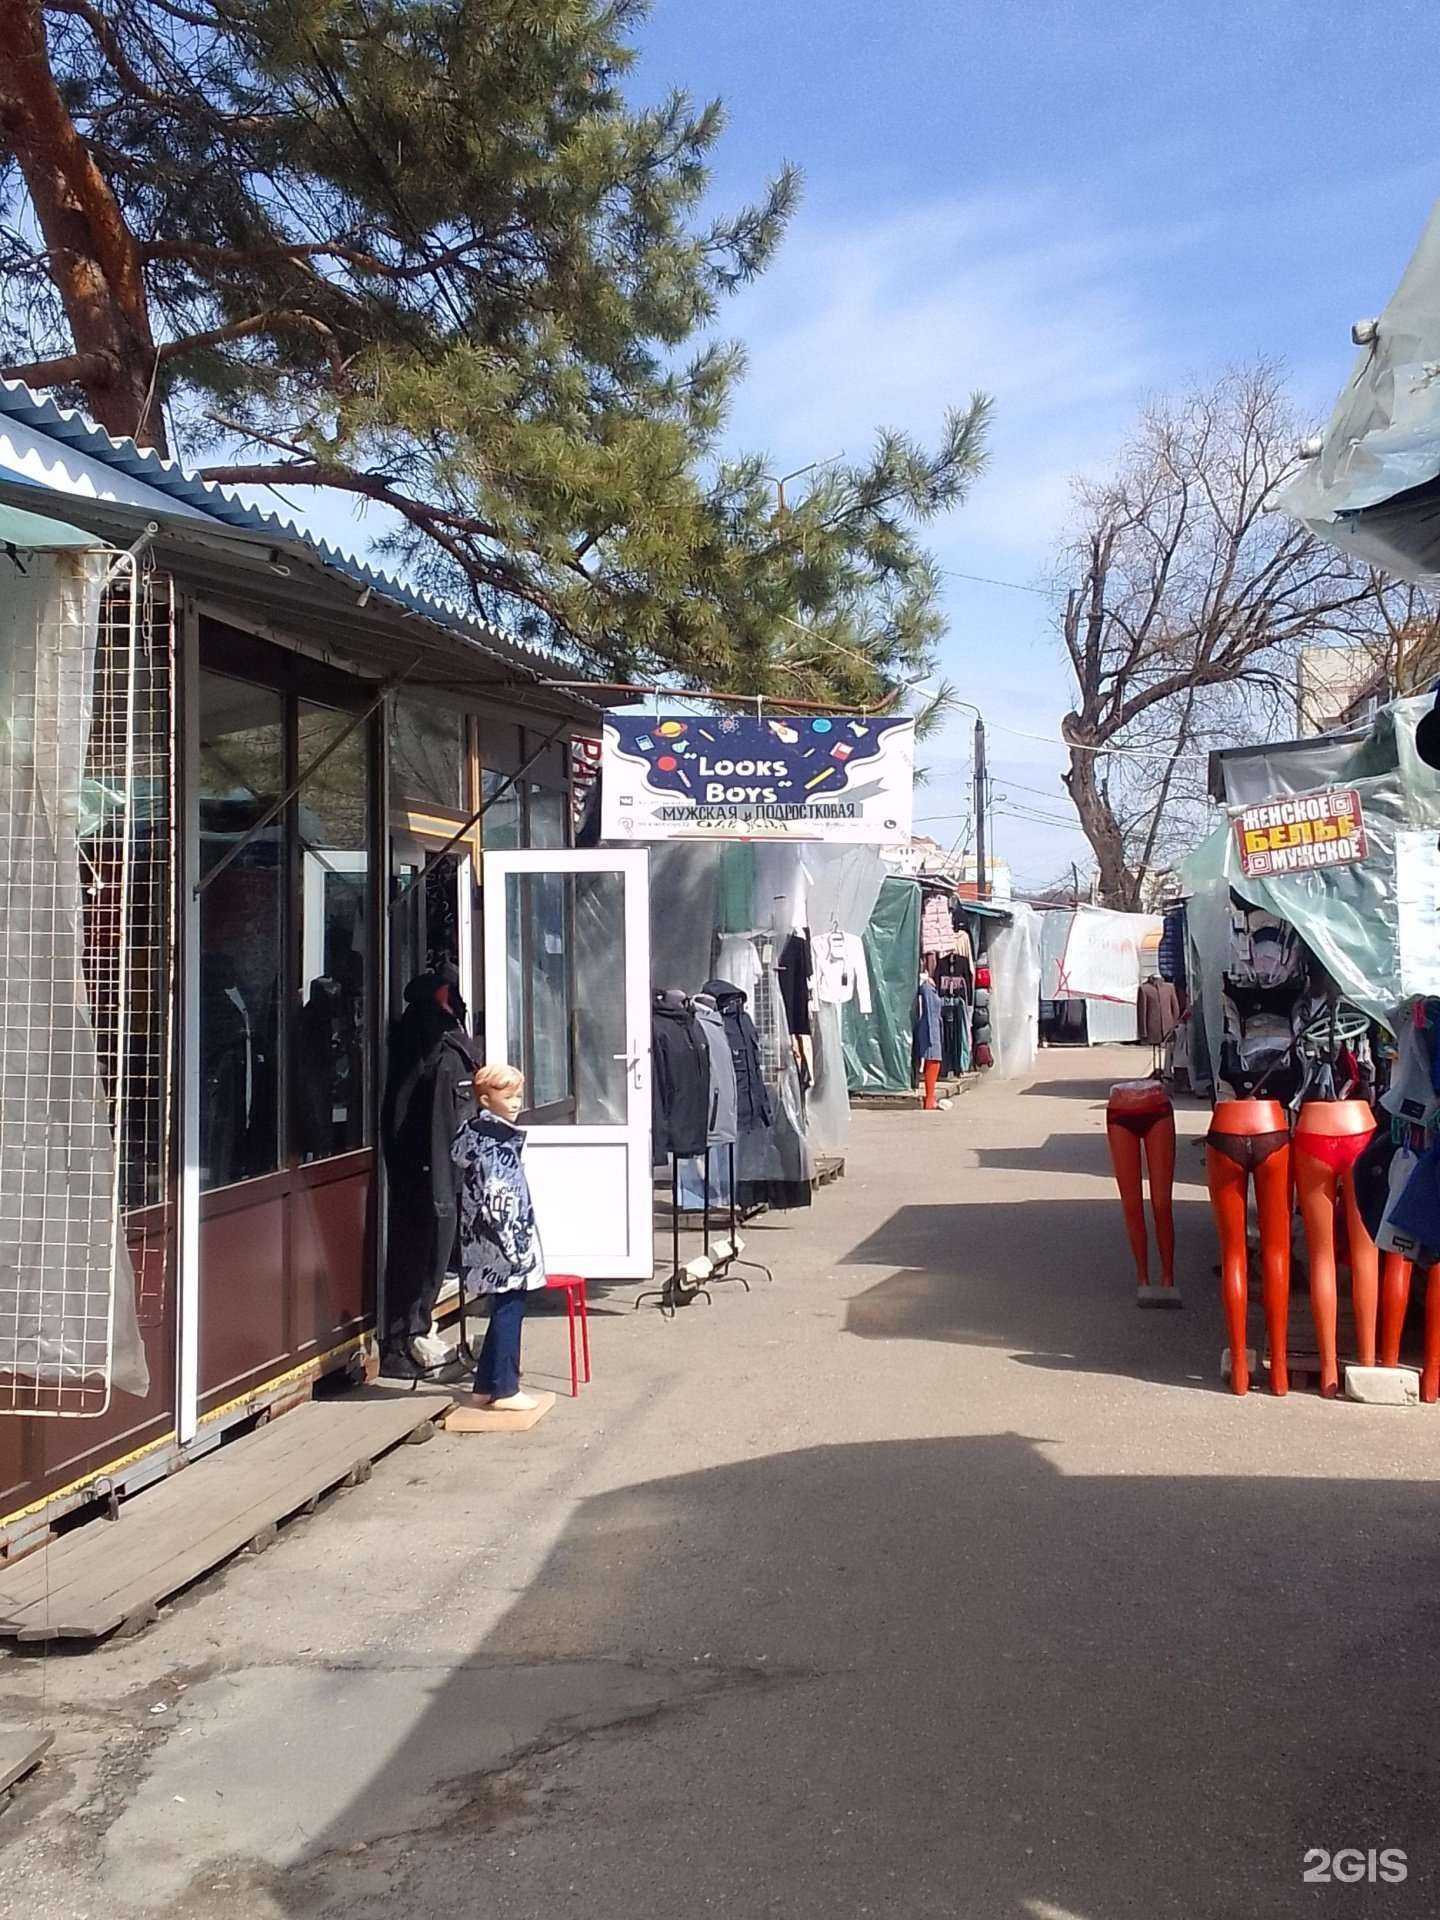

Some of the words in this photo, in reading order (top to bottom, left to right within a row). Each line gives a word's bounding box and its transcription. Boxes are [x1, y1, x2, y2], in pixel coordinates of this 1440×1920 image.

[663, 806, 738, 821] МУЖСКАЯ
[755, 803, 855, 820] ПОДРОСТКОВАЯ
[1243, 799, 1330, 830] ЖЕНСКОЕ
[1245, 815, 1355, 853] БЕЛЬЕ
[1271, 837, 1361, 870] МУЖСКОЕ
